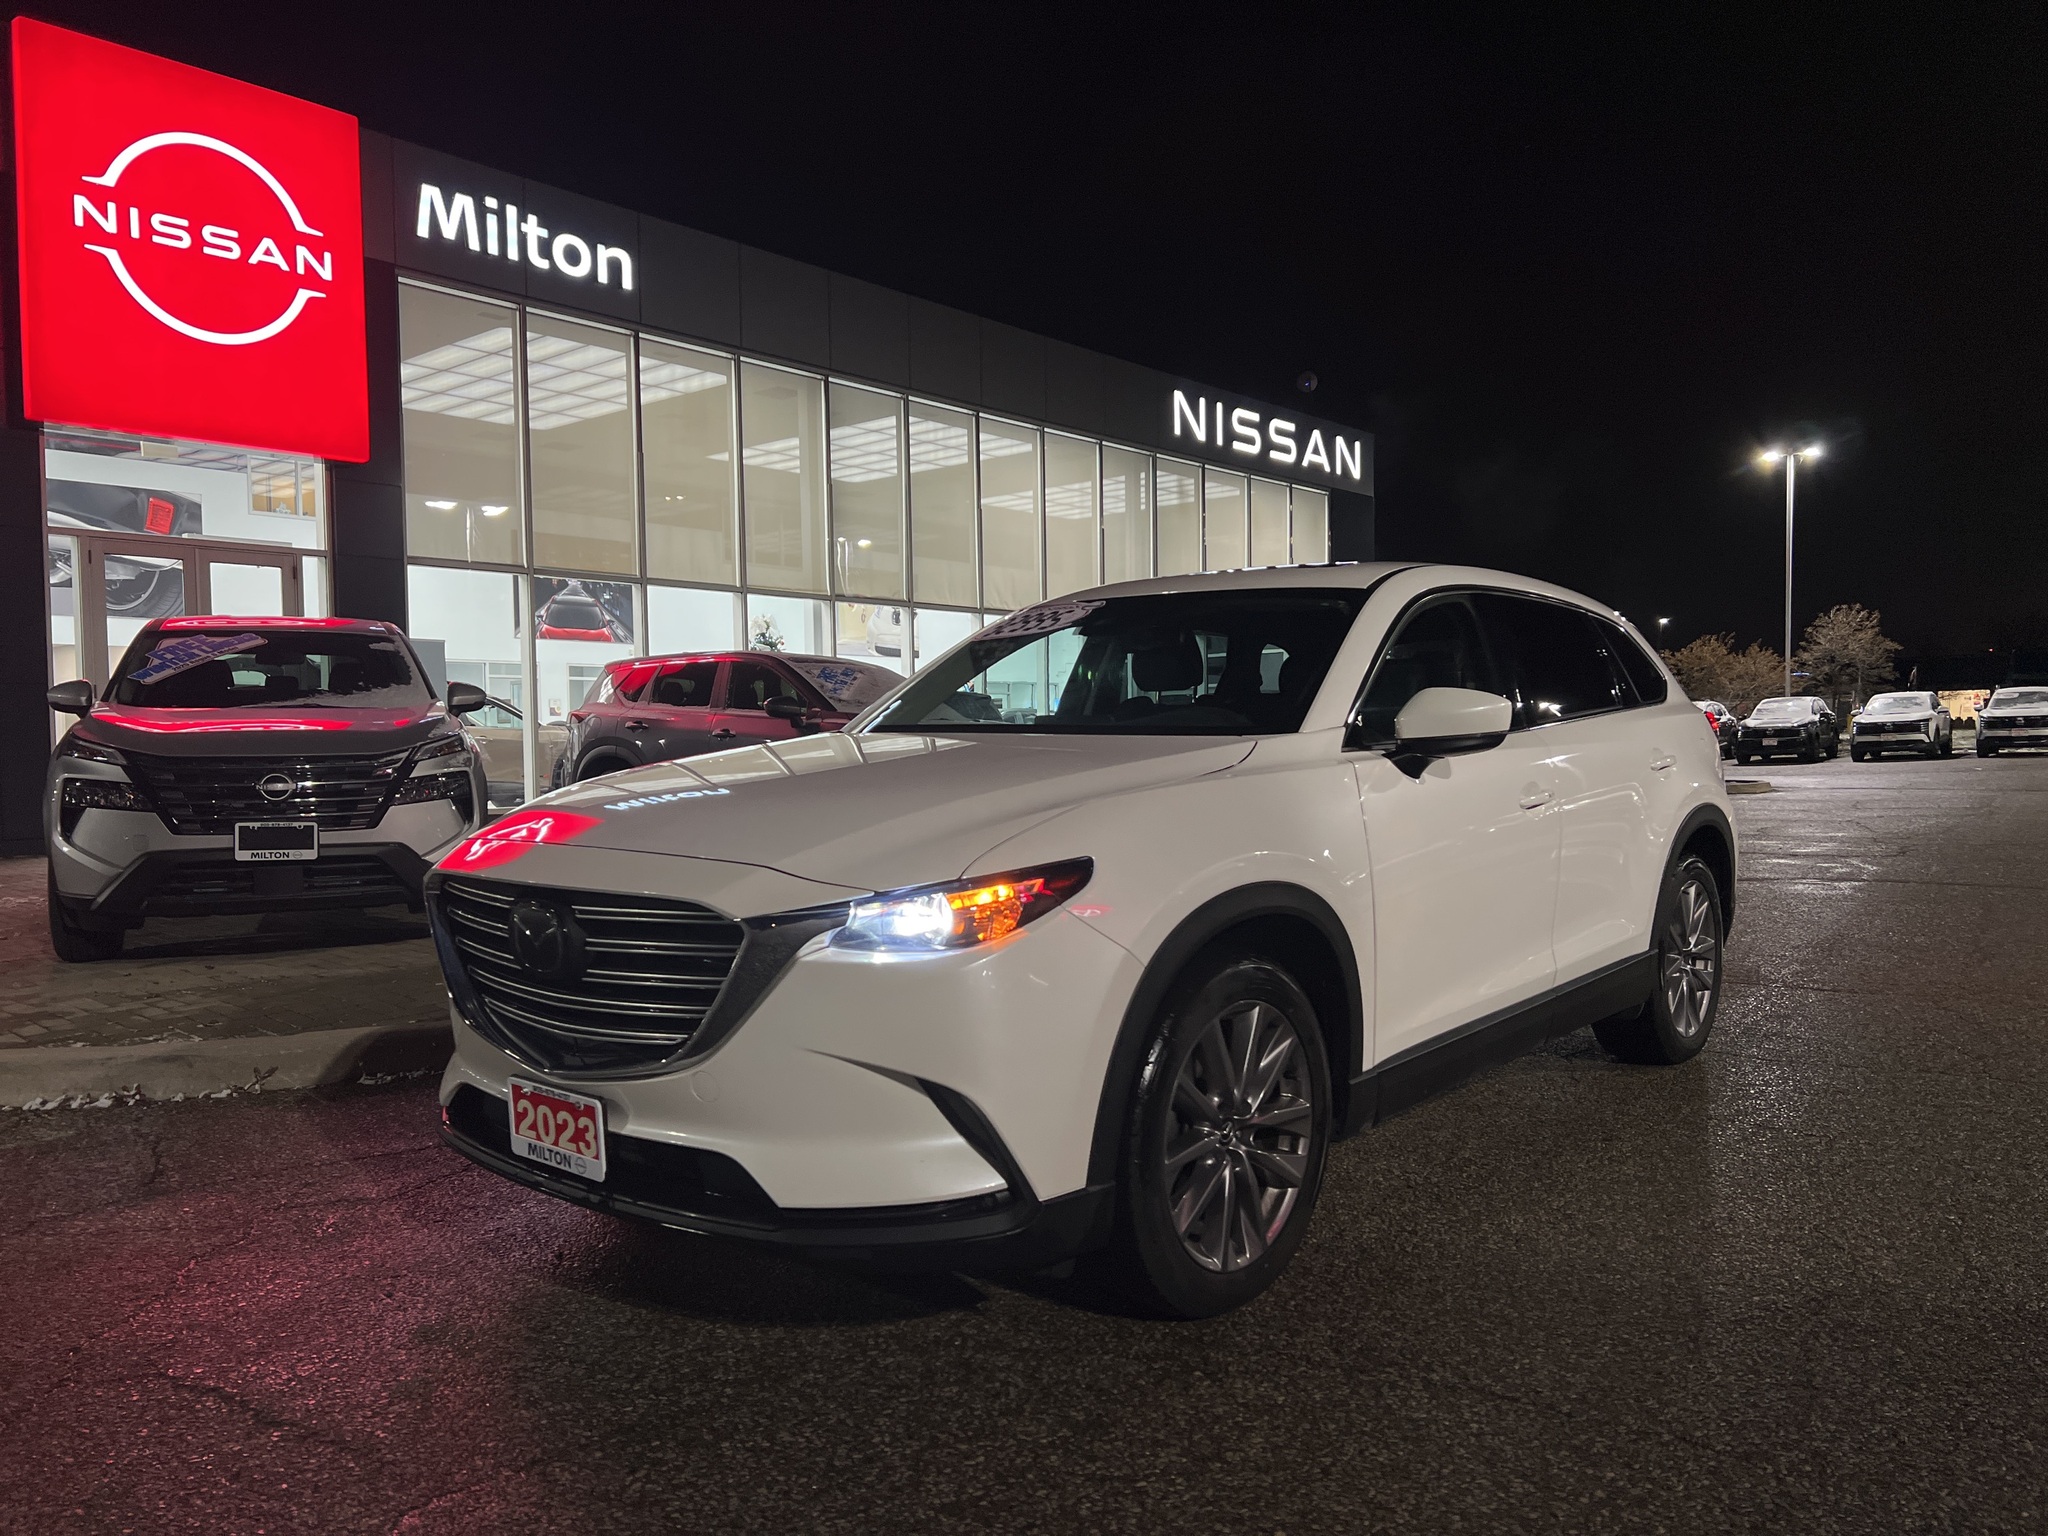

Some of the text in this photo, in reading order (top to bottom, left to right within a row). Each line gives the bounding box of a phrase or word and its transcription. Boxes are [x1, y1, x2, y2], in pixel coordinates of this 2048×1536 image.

[73, 194, 333, 281] NISSAN
[416, 182, 634, 291] Milton
[1173, 389, 1362, 481] NISSAN
[128, 651, 207, 680] WINTER
[146, 634, 216, 661] FREE
[250, 851, 290, 860] MILTON
[516, 1098, 598, 1159] 2023
[527, 1142, 572, 1170] MILTON
